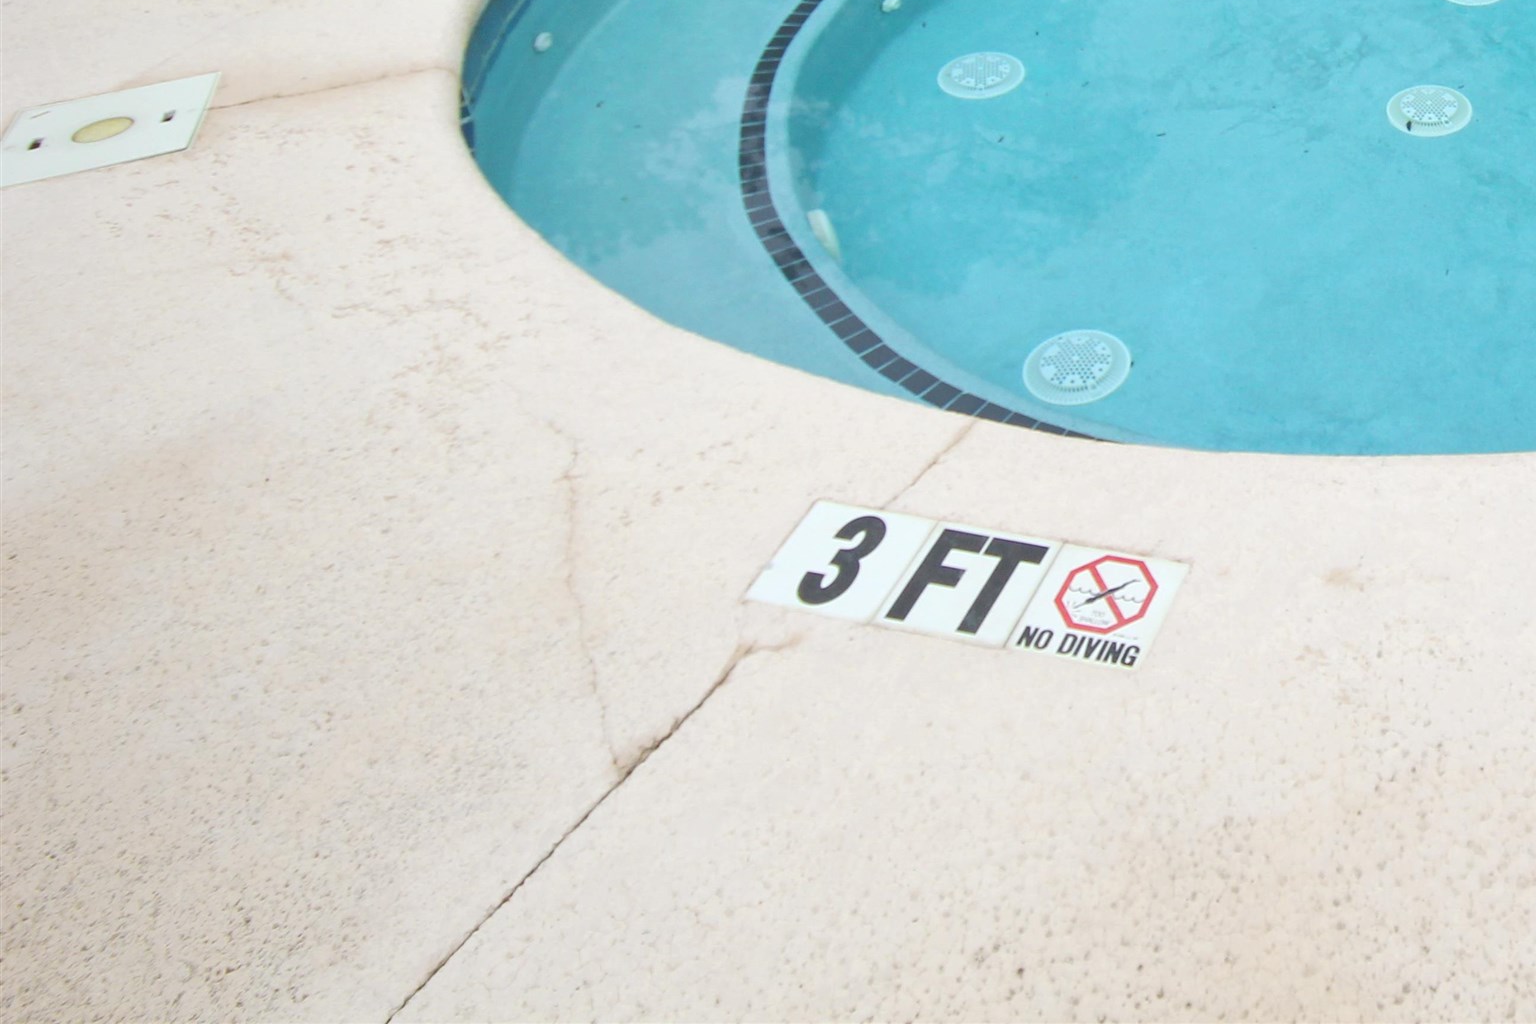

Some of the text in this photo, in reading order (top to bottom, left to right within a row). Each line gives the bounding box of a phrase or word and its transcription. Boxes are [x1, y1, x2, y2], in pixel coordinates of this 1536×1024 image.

[797, 515, 1050, 635] 3 FT
[1016, 625, 1141, 668] NO DIVING
